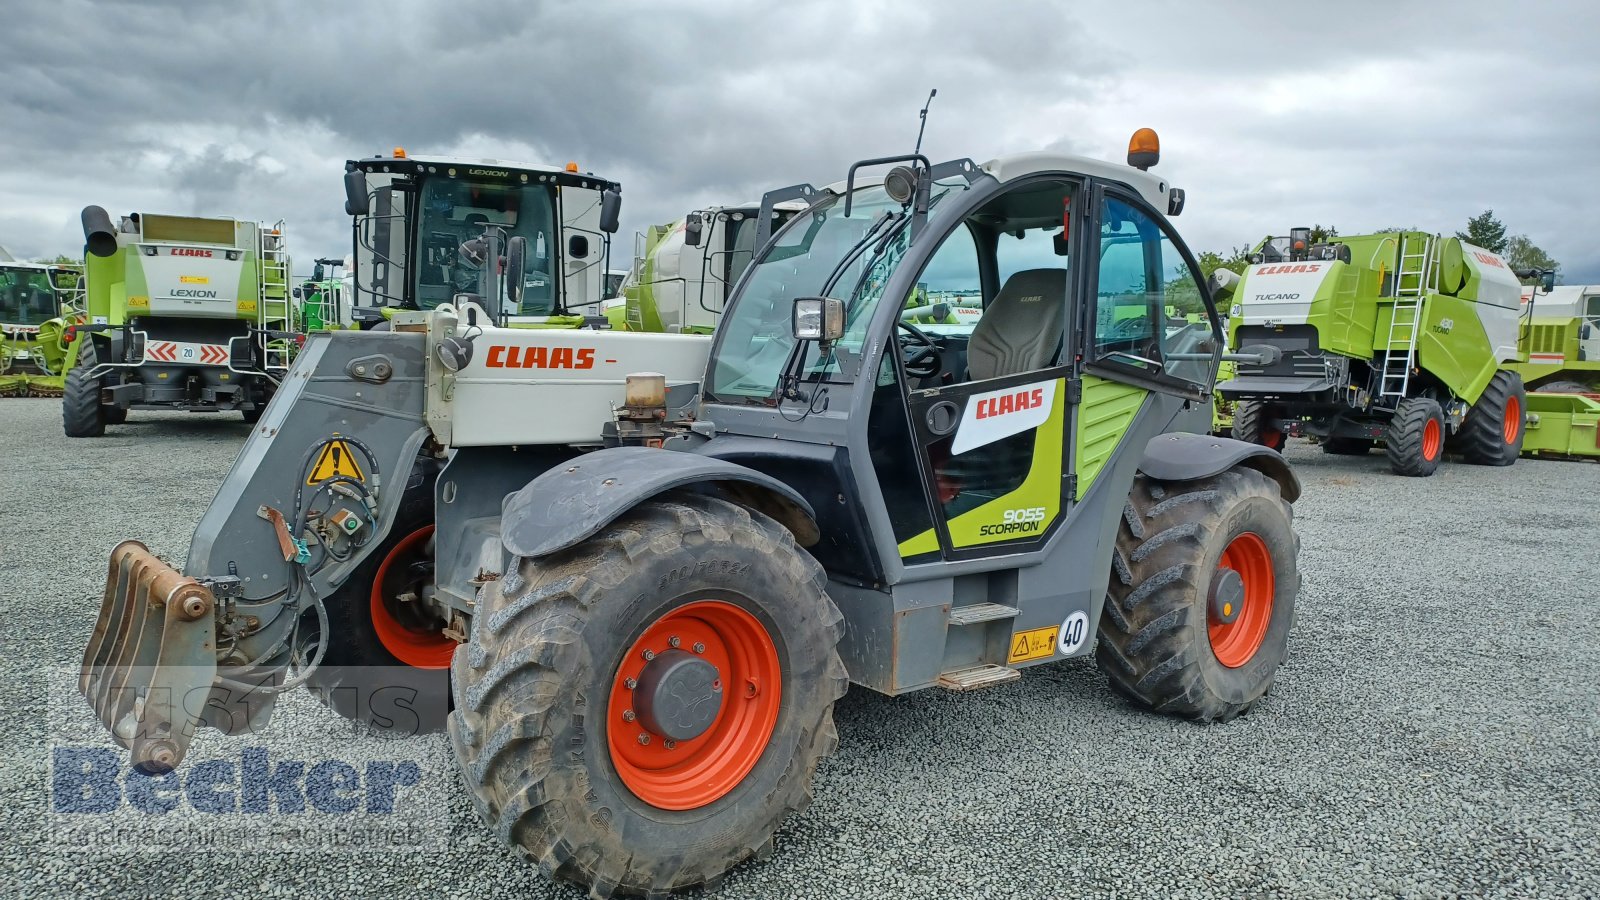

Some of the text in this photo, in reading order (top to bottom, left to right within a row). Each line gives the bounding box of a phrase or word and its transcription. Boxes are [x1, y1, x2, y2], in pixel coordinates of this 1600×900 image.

[469, 168, 509, 177] LEXION
[170, 248, 213, 258] CLAAS
[1256, 264, 1321, 276] CLAAS
[170, 289, 217, 298] LEXION
[1255, 293, 1300, 301] TUCANO
[1232, 305, 1240, 315] 20
[183, 348, 193, 358] 20
[485, 345, 596, 370] CLAAS
[975, 388, 1043, 420] CLAAS
[1003, 507, 1046, 524] 9055
[979, 521, 1040, 536] SCORPION
[1063, 618, 1084, 648] 40
